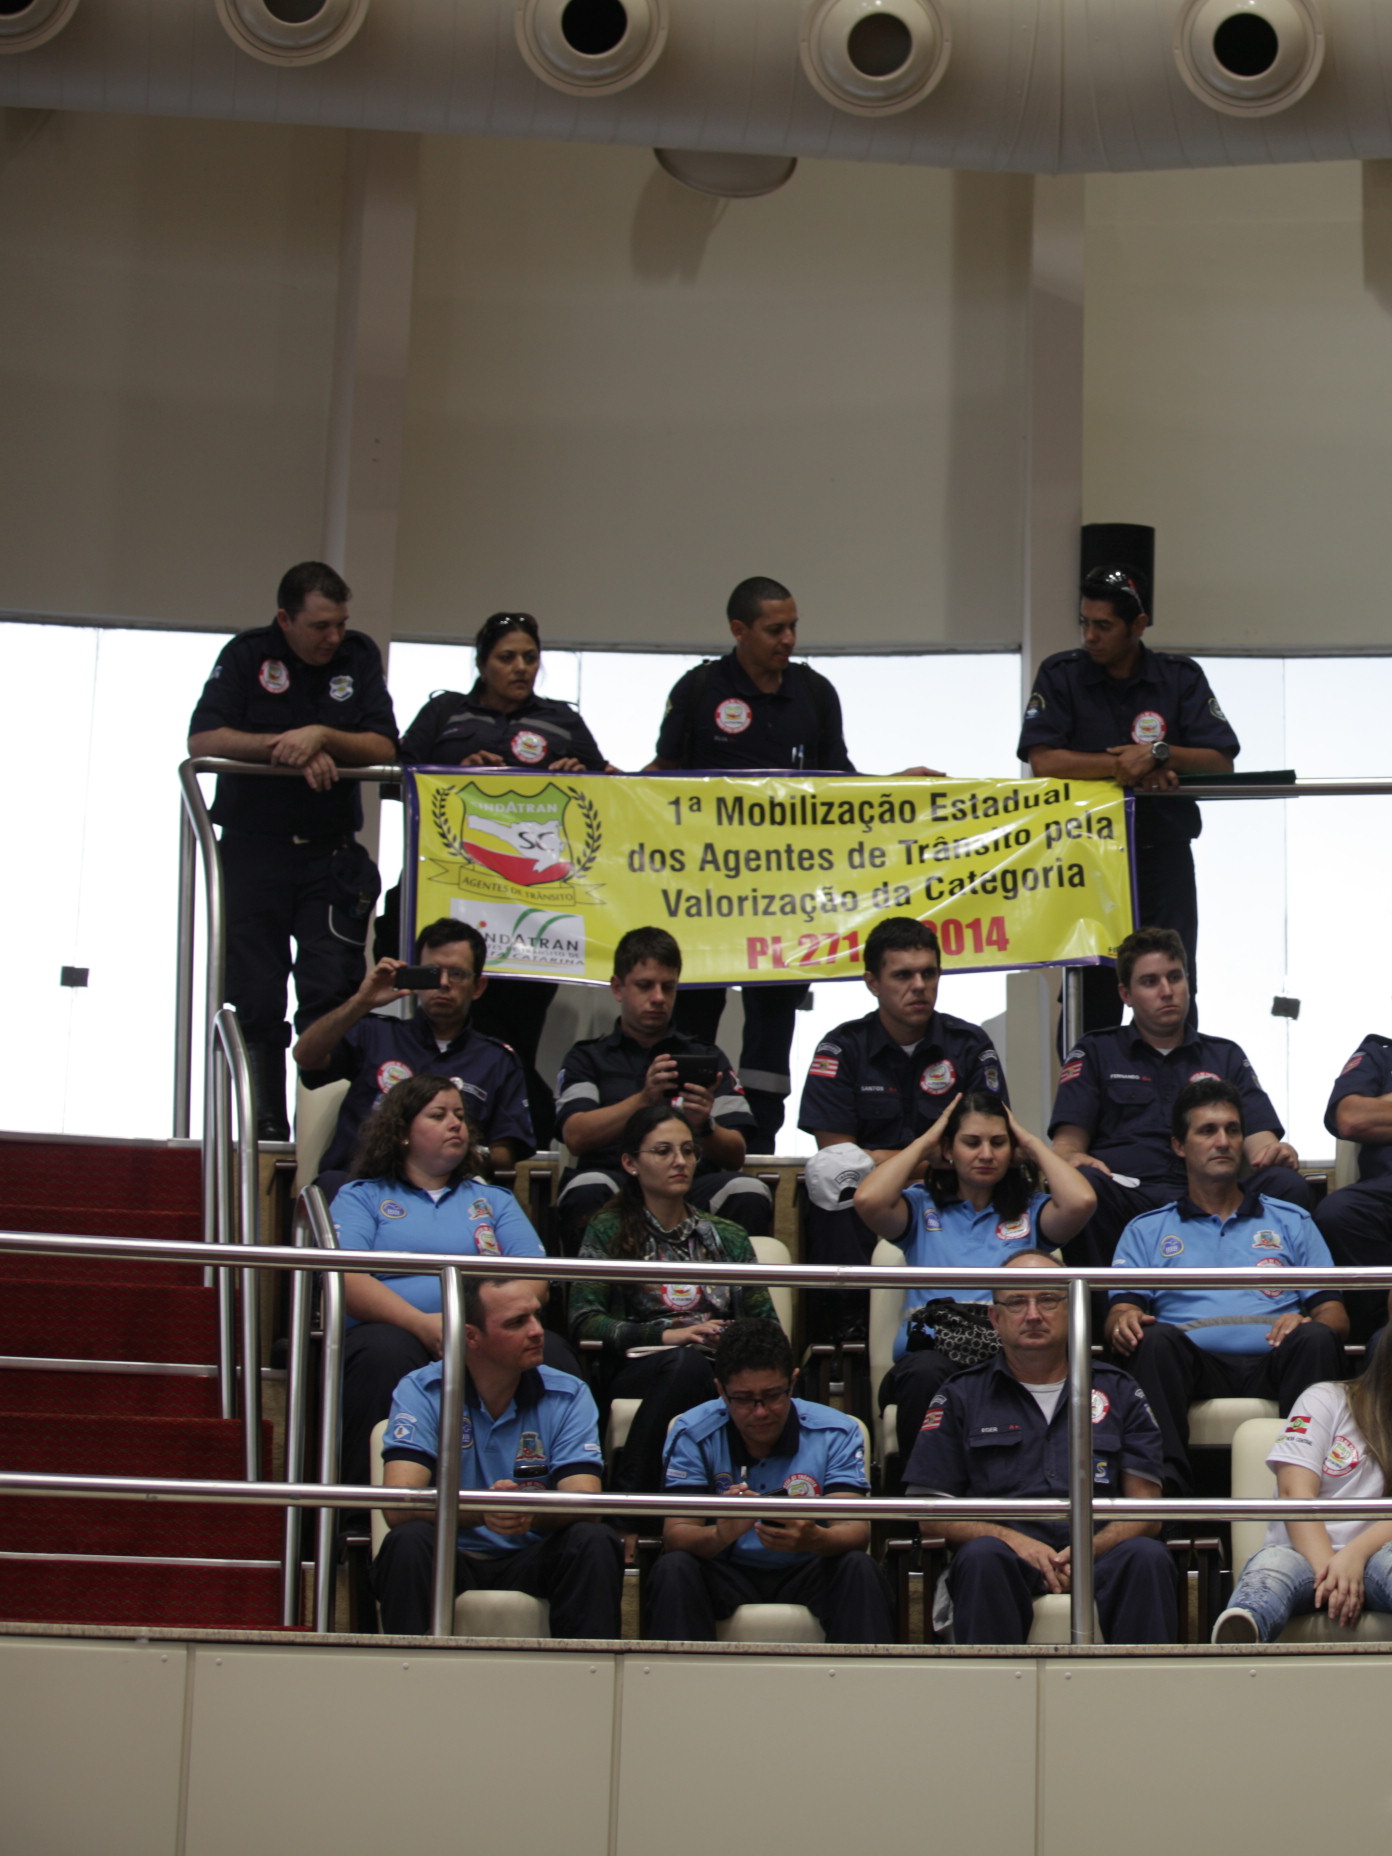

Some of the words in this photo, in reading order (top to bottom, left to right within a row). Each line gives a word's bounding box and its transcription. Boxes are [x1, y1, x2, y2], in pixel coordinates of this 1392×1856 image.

[668, 796, 702, 826] 1ª
[716, 793, 916, 833] Mobilização
[930, 783, 1071, 822] Estadual
[518, 831, 556, 851] SC
[628, 842, 686, 873] dos
[699, 842, 834, 879] Agentes
[848, 841, 886, 870] de
[898, 827, 1031, 866] Trânsito
[1046, 812, 1114, 849] pela
[661, 885, 858, 922] Valorização
[872, 881, 911, 909] da
[925, 858, 1086, 900] Categoria
[484, 932, 579, 951] NDATRAN
[747, 936, 788, 969] PL
[921, 916, 1010, 957] 014
